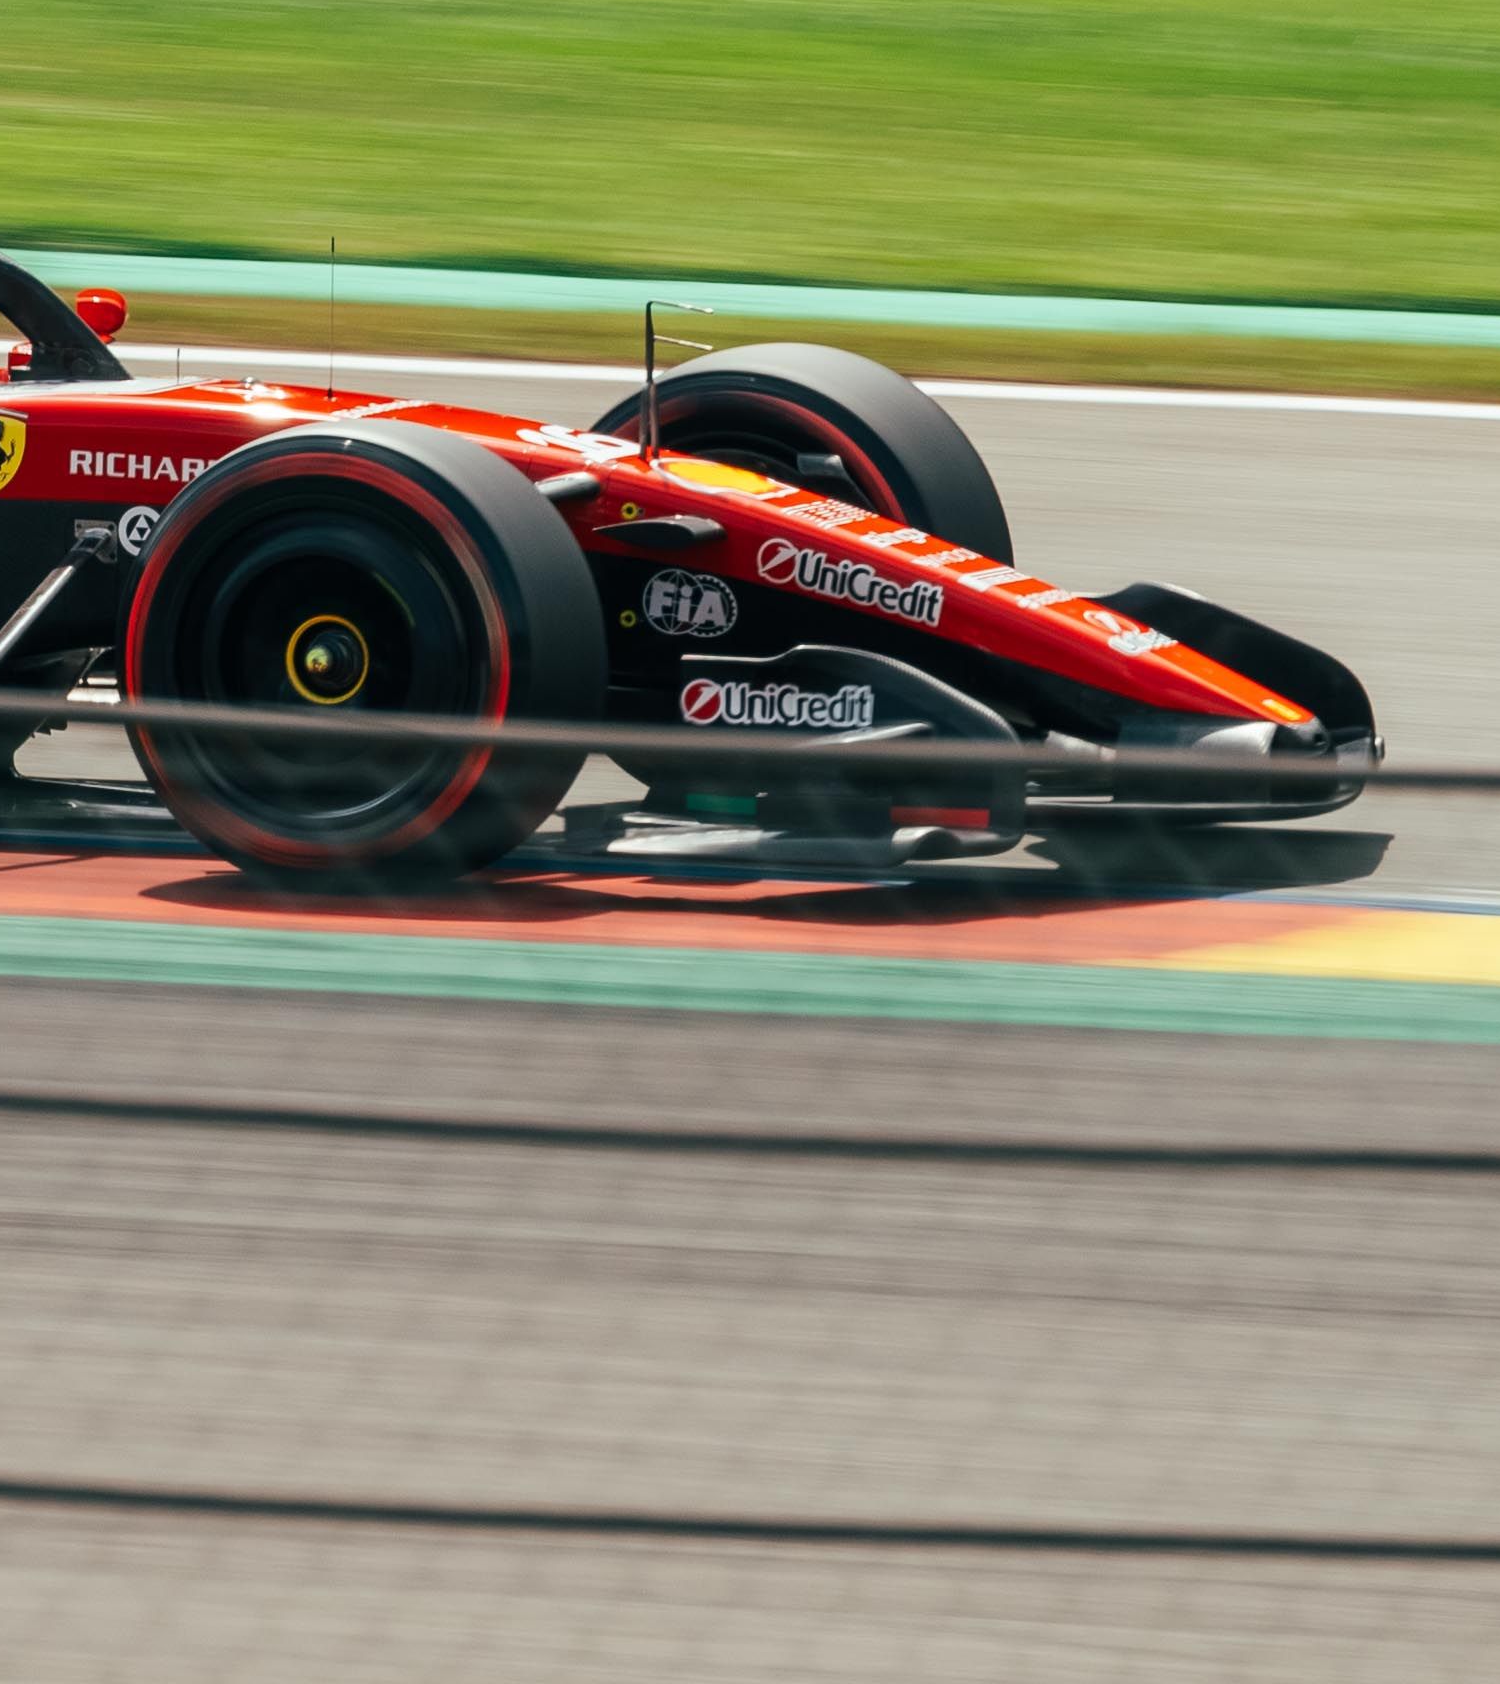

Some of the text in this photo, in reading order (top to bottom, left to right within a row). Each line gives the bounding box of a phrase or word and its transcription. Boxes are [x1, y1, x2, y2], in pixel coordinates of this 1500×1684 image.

[69, 449, 218, 482] RICHAR
[798, 551, 943, 624] UniCredit
[725, 684, 870, 726] UniCredit
